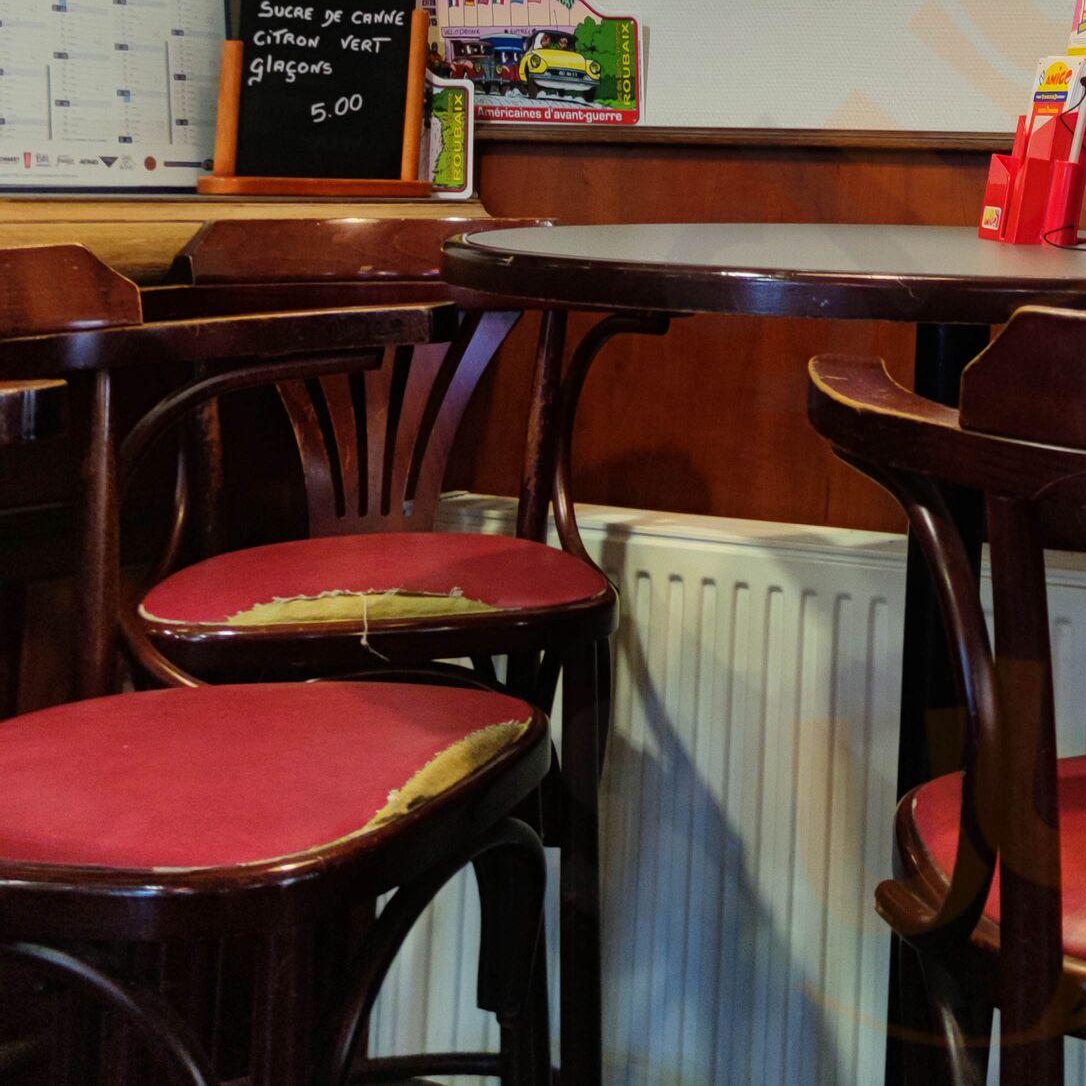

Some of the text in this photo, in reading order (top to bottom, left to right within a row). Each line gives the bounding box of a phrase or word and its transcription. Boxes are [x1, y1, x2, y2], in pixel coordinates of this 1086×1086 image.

[258, 0, 314, 21] SUCRE
[351, 9, 405, 26] CANNE
[340, 34, 392, 54] VERT
[621, 22, 632, 106] ROUBAIX
[310, 93, 364, 123] 5.00
[477, 105, 623, 123] Américaines d'avant-guerre
[453, 93, 464, 182] ROUBAIX
